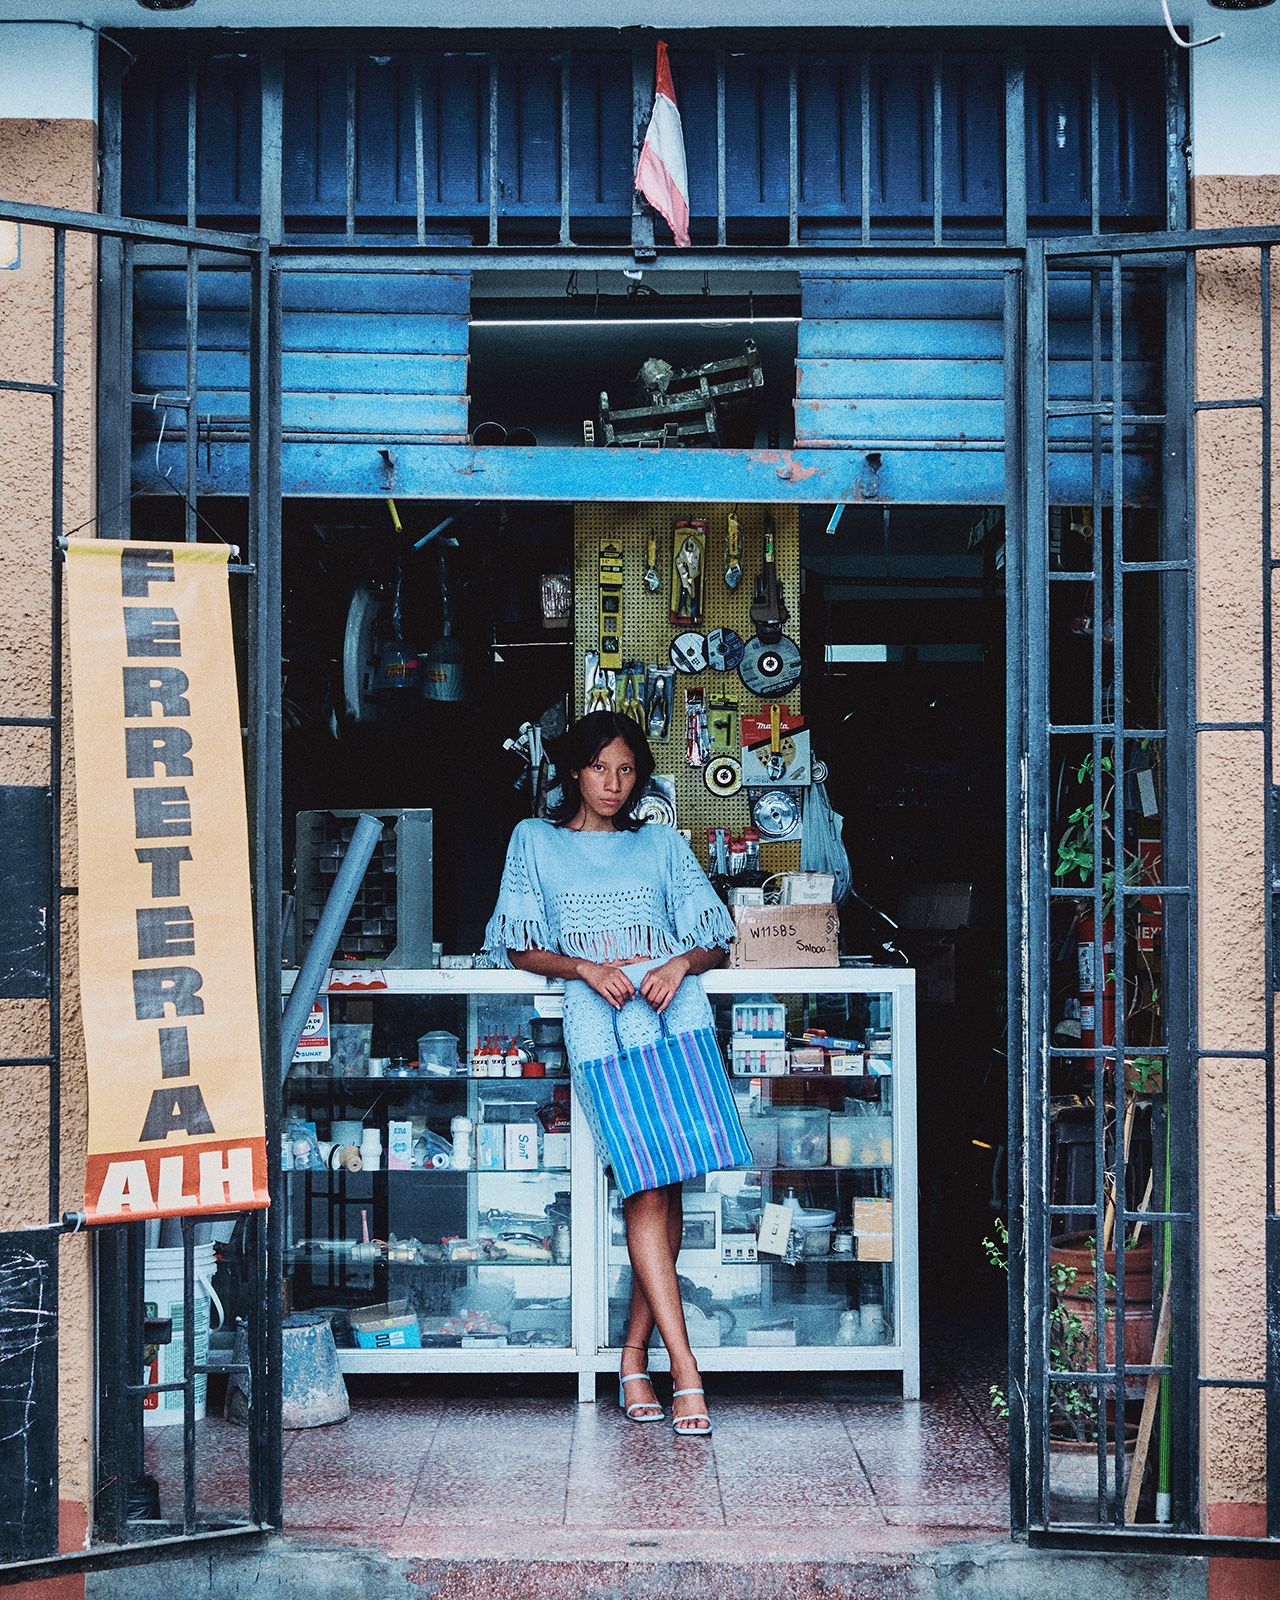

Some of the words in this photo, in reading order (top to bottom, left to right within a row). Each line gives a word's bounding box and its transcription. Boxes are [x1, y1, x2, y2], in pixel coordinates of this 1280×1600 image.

[121, 548, 216, 1142] FERRETERIA
[750, 924, 797, 939] W11585
[1142, 926, 1162, 939] EX
[96, 1147, 257, 1215] ALH
